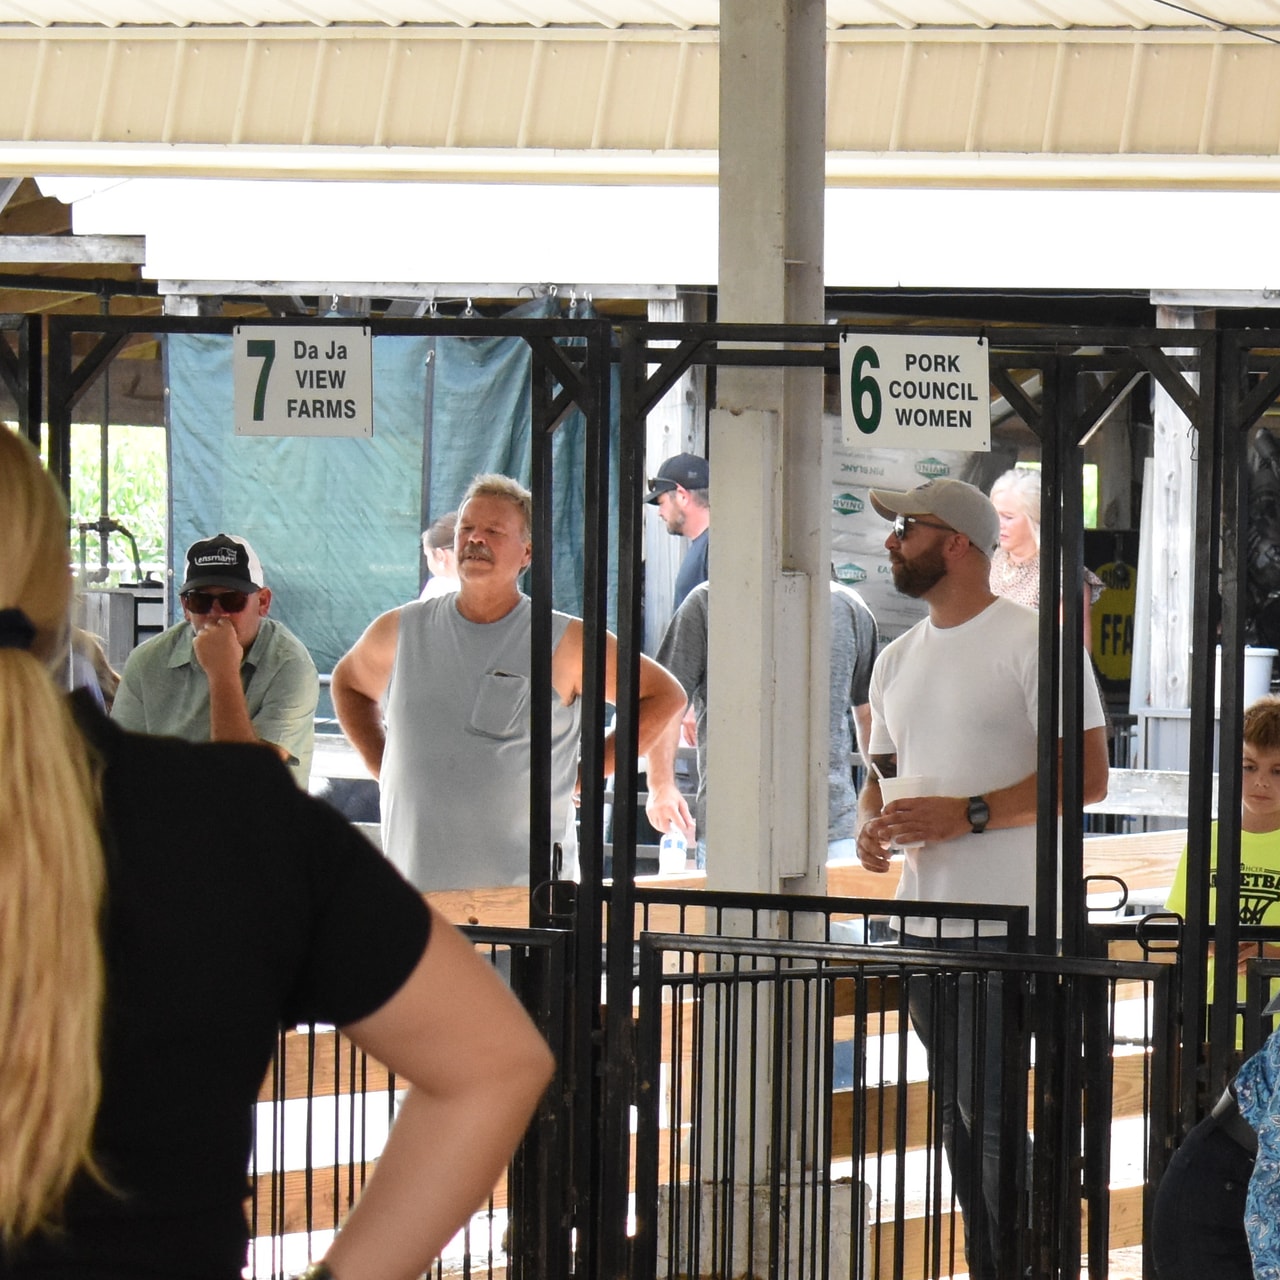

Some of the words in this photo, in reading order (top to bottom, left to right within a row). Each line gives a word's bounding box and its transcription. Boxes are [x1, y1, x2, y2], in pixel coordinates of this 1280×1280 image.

[294, 341, 318, 359] Da
[325, 341, 347, 359] Ja
[906, 354, 960, 372] PORK
[247, 340, 275, 421] 7
[296, 370, 346, 389] VIEW
[851, 346, 882, 434] 6
[889, 381, 978, 400] COUNCIL
[288, 399, 355, 418] FARMS
[895, 408, 971, 427] WOMEN
[832, 500, 865, 510] RVING
[1101, 614, 1133, 656] FFA
